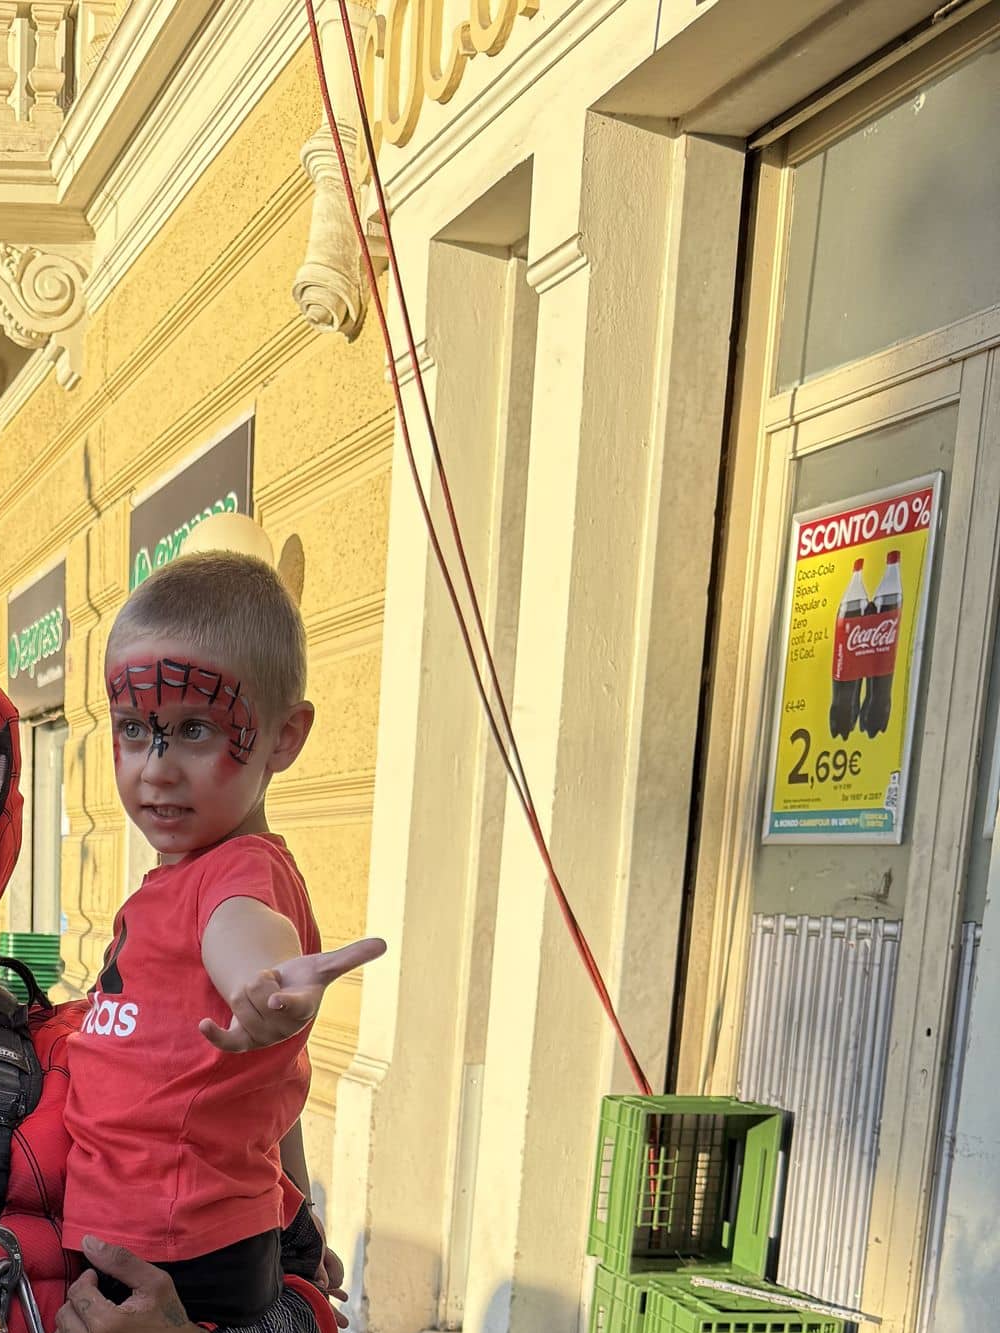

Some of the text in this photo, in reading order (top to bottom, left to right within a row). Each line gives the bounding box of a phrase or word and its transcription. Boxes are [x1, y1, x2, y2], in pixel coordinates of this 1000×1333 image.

[800, 495, 930, 556] SCONTO 40 %
[797, 563, 835, 582] Coca-Cola
[794, 598, 828, 615] Regular o
[792, 618, 808, 630] Zero
[807, 630, 813, 643] 2
[814, 631, 823, 644] pz
[824, 627, 829, 640] L
[847, 618, 898, 651] Coca-Cola
